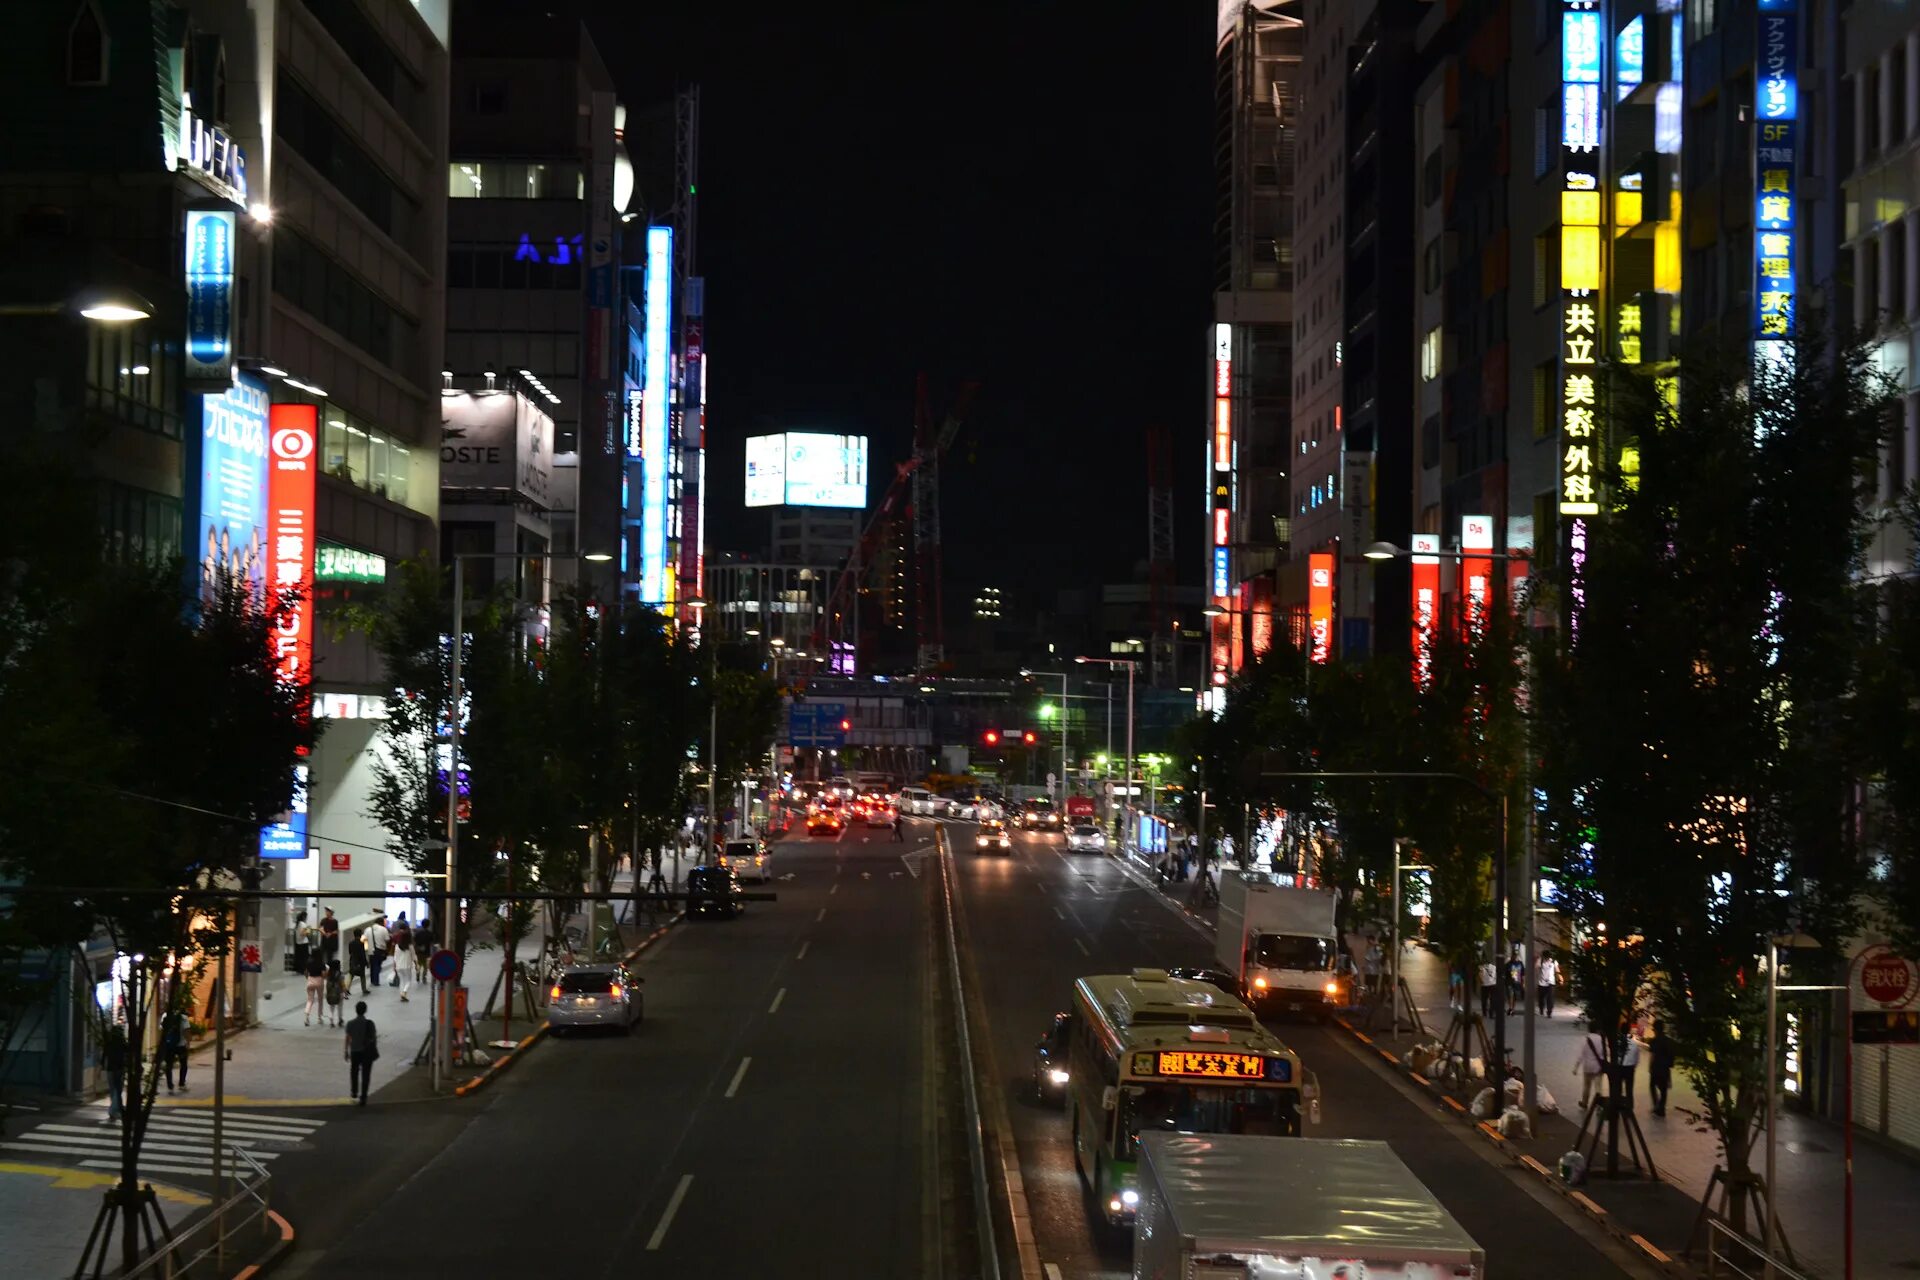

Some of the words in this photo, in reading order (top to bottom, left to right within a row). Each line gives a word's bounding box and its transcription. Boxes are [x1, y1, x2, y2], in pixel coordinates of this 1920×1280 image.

[1767, 17, 1787, 117] アクアヴィジョン
[1763, 125, 1789, 142] 5F
[1759, 147, 1793, 163] 不動産
[1564, 303, 1595, 502] 共立美容外科
[441, 446, 500, 464] OSTE
[1864, 968, 1906, 987] 消火栓
